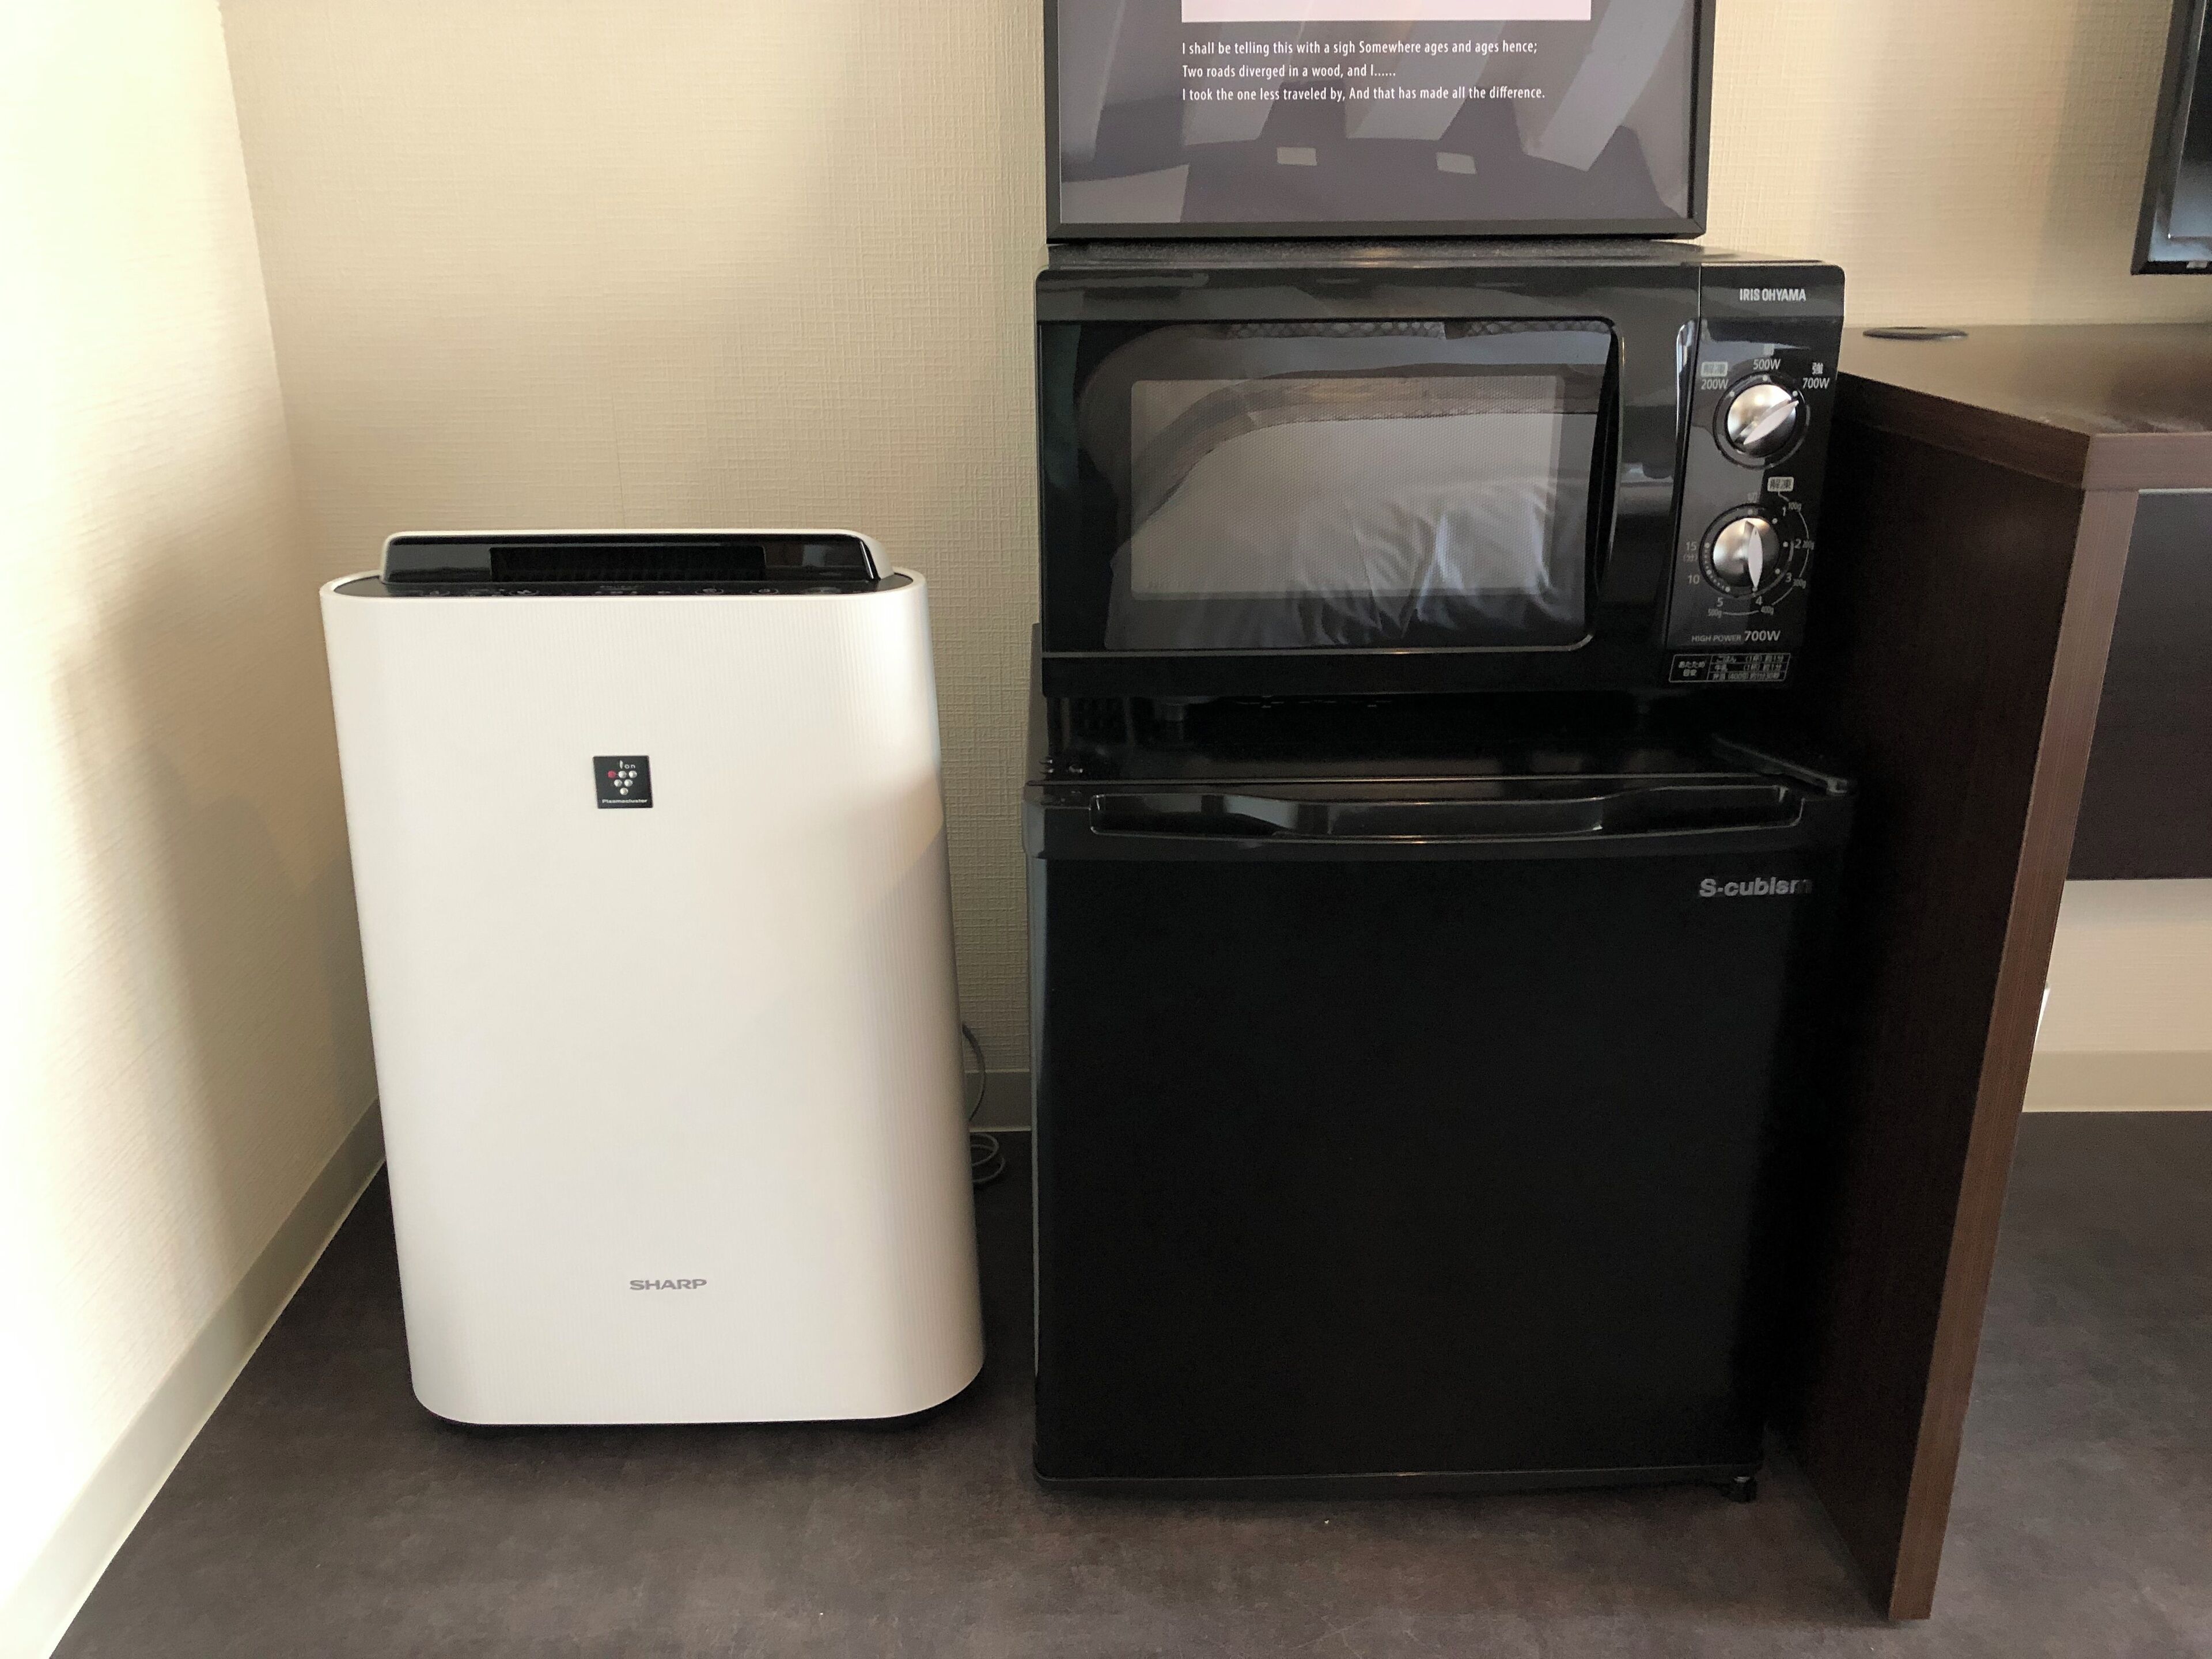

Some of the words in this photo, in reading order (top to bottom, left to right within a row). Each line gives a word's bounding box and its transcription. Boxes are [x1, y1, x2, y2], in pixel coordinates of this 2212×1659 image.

[1182, 42, 1185, 55] I
[1189, 41, 1214, 55] shall
[1218, 41, 1231, 55] be
[1234, 41, 1270, 57] telling
[1272, 41, 1293, 54] this
[1296, 40, 1320, 54] with
[1324, 43, 1330, 54] a
[1333, 40, 1355, 57] sigh
[1359, 40, 1421, 54] Somewhere
[1424, 43, 1449, 56] ages
[1452, 39, 1471, 53] and
[1475, 42, 1499, 56] ages
[1502, 39, 1537, 54] hence;
[1182, 65, 1203, 78] Two
[1207, 64, 1236, 78] roads
[1238, 64, 1285, 80] diverged
[1289, 64, 1299, 77] in
[1302, 67, 1308, 77] a
[1311, 63, 1344, 78] wood,
[1347, 63, 1367, 77] and
[1182, 88, 1185, 101] I
[1189, 88, 1213, 101] took
[1216, 87, 1234, 101] the
[1237, 90, 1256, 101] one
[1260, 87, 1280, 100] less
[1283, 86, 1327, 101] traveled
[1330, 86, 1346, 103] by,
[1349, 86, 1370, 100] And
[1373, 86, 1395, 100] that
[1399, 86, 1416, 99] has
[1419, 86, 1449, 99] made
[1452, 85, 1465, 99] all
[1468, 86, 1486, 99] the
[1489, 85, 1545, 99] difference.
[1740, 289, 1760, 301] IRIS
[1762, 289, 1806, 301] OHYAMA
[1753, 359, 1781, 370] 500W
[1701, 378, 1729, 390] 200W
[1802, 377, 1830, 389] 700W
[1770, 478, 1792, 489] 解凍
[1782, 506, 1786, 516] 1
[1686, 541, 1696, 551] 15
[1795, 539, 1801, 549] 2
[1688, 575, 1700, 585] 10
[1786, 573, 1792, 582] 3
[1717, 598, 1724, 607] 5
[1756, 596, 1763, 604] 4
[1744, 630, 1781, 641] 700W
[619, 760, 636, 769] Ion
[1699, 877, 1813, 897] S-cubism
[630, 1279, 707, 1291] SHARP
